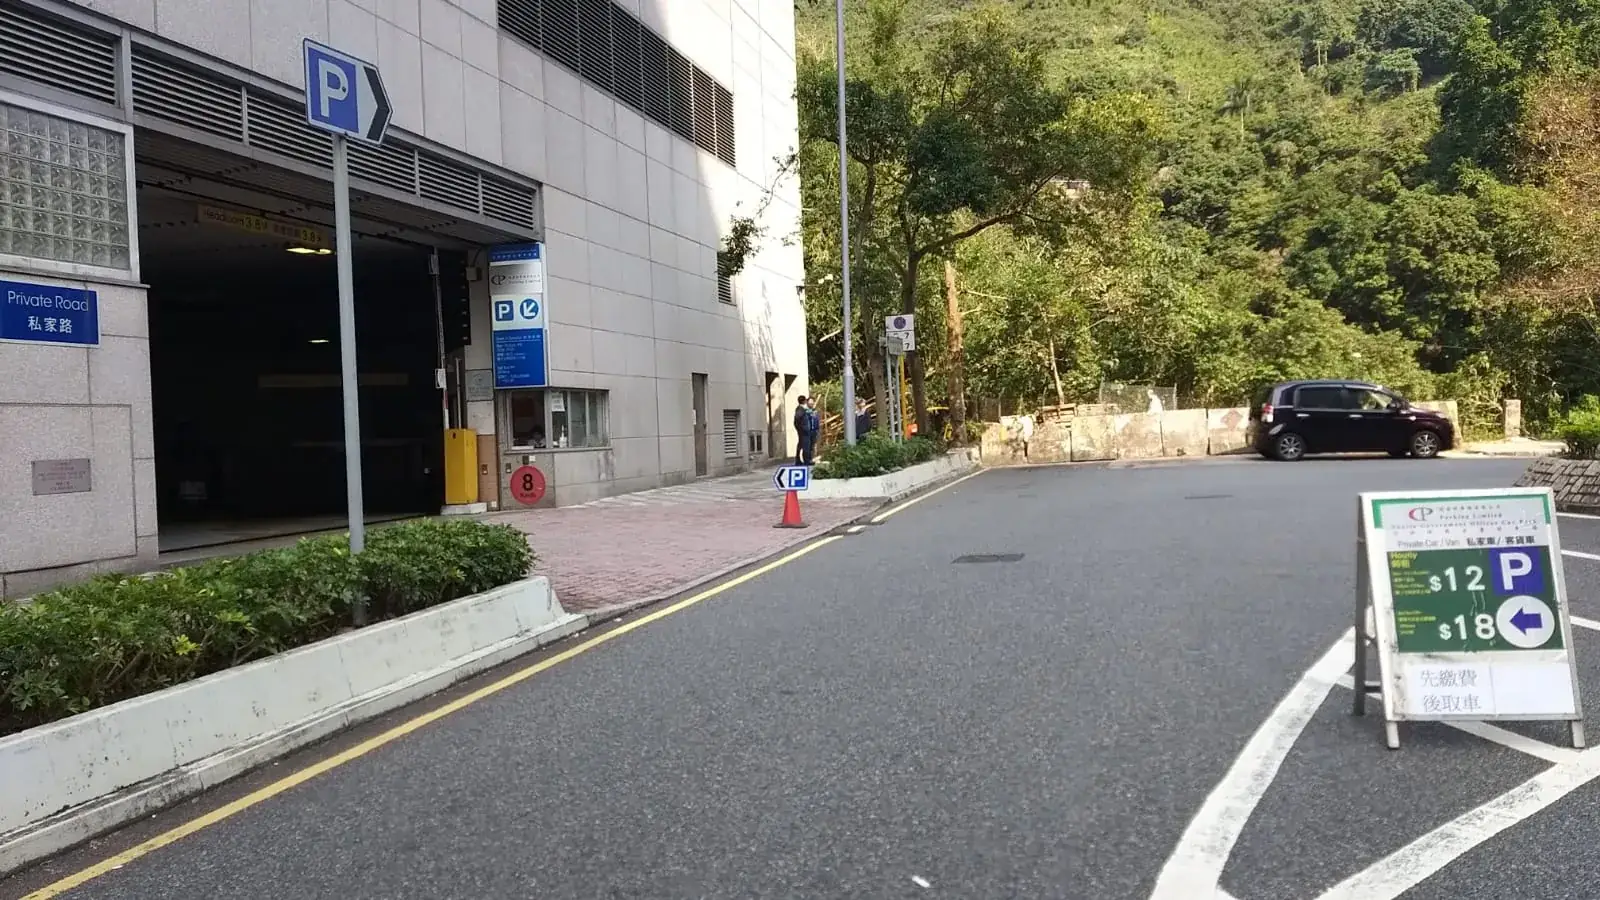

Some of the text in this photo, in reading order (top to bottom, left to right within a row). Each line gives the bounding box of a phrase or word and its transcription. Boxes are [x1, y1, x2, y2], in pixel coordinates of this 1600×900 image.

[318, 58, 349, 118] P
[7, 290, 89, 312] Private Road
[498, 303, 510, 319] P
[28, 315, 72, 334] 私家路
[523, 473, 533, 491] 8
[791, 470, 803, 486] P
[1429, 565, 1485, 592] $12
[1500, 552, 1532, 590] P
[1439, 613, 1495, 640] $18
[1420, 669, 1477, 688] 先繳費
[1423, 694, 1481, 712] 後取車
